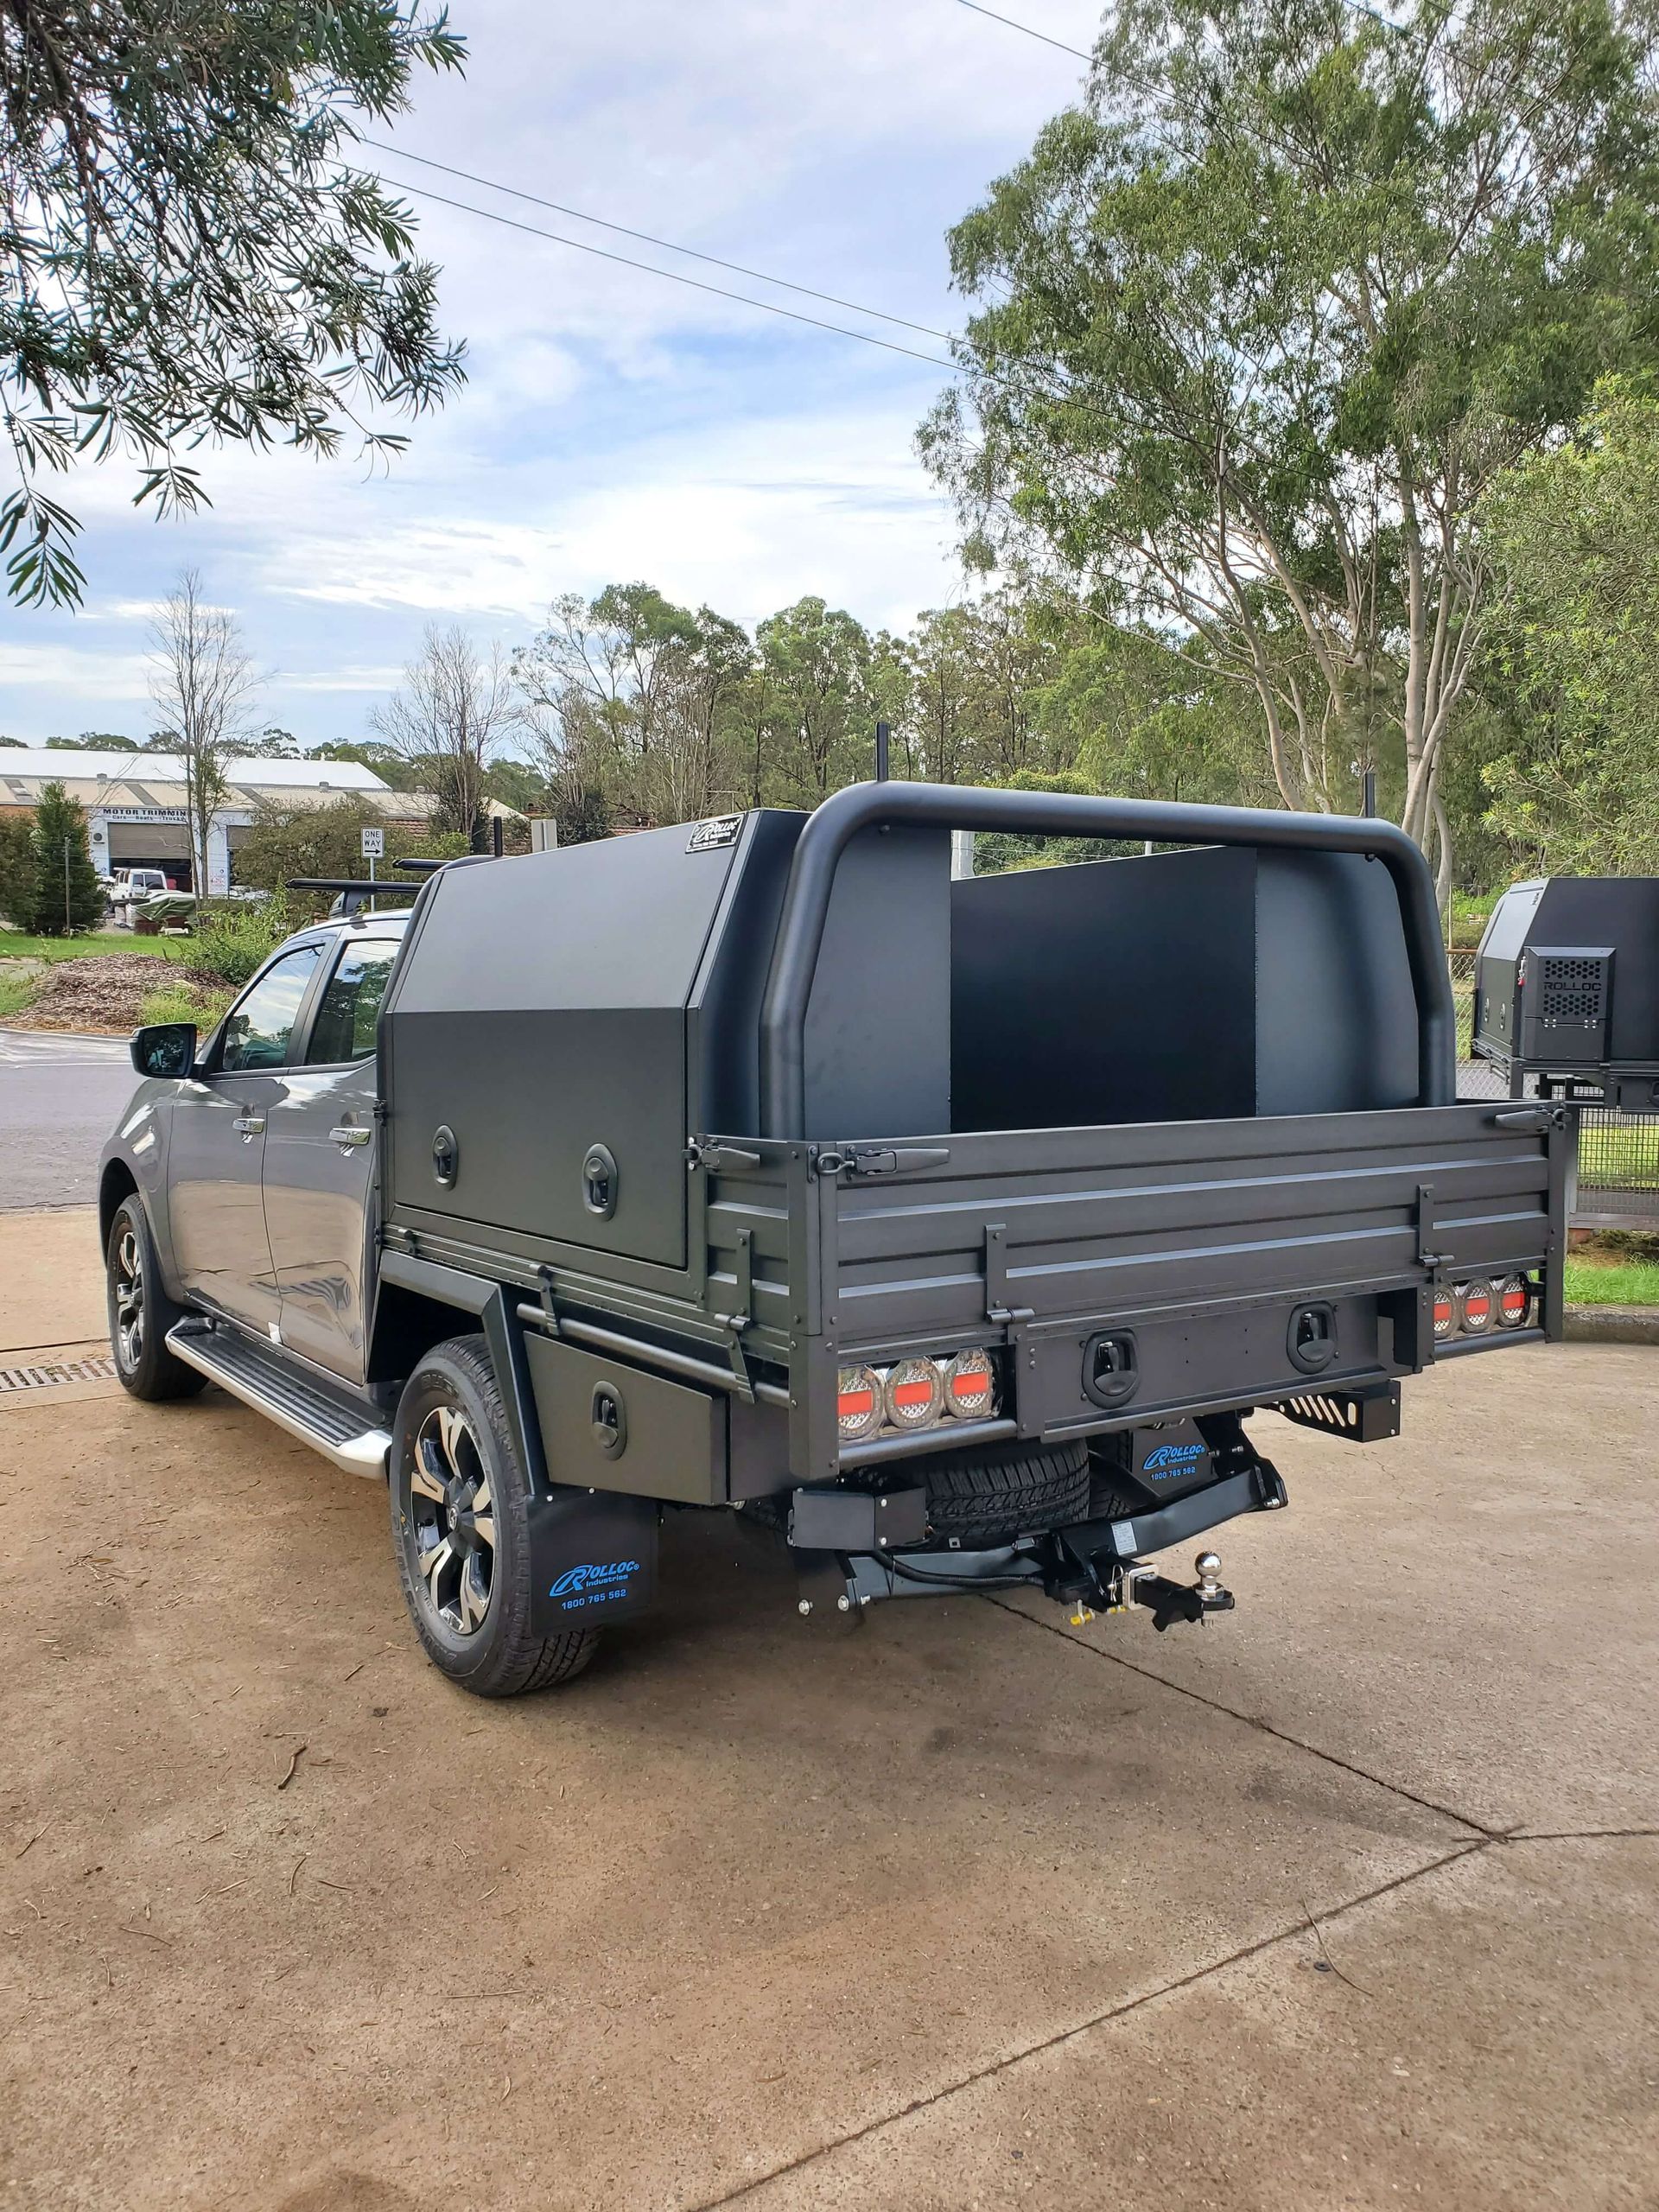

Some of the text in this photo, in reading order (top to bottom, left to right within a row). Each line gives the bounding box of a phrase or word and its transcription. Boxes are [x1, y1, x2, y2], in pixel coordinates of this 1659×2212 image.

[1543, 982, 1602, 991] ROLLOC
[586, 1573, 629, 1588] Industries
[561, 1588, 626, 1611] 1800 765 562
